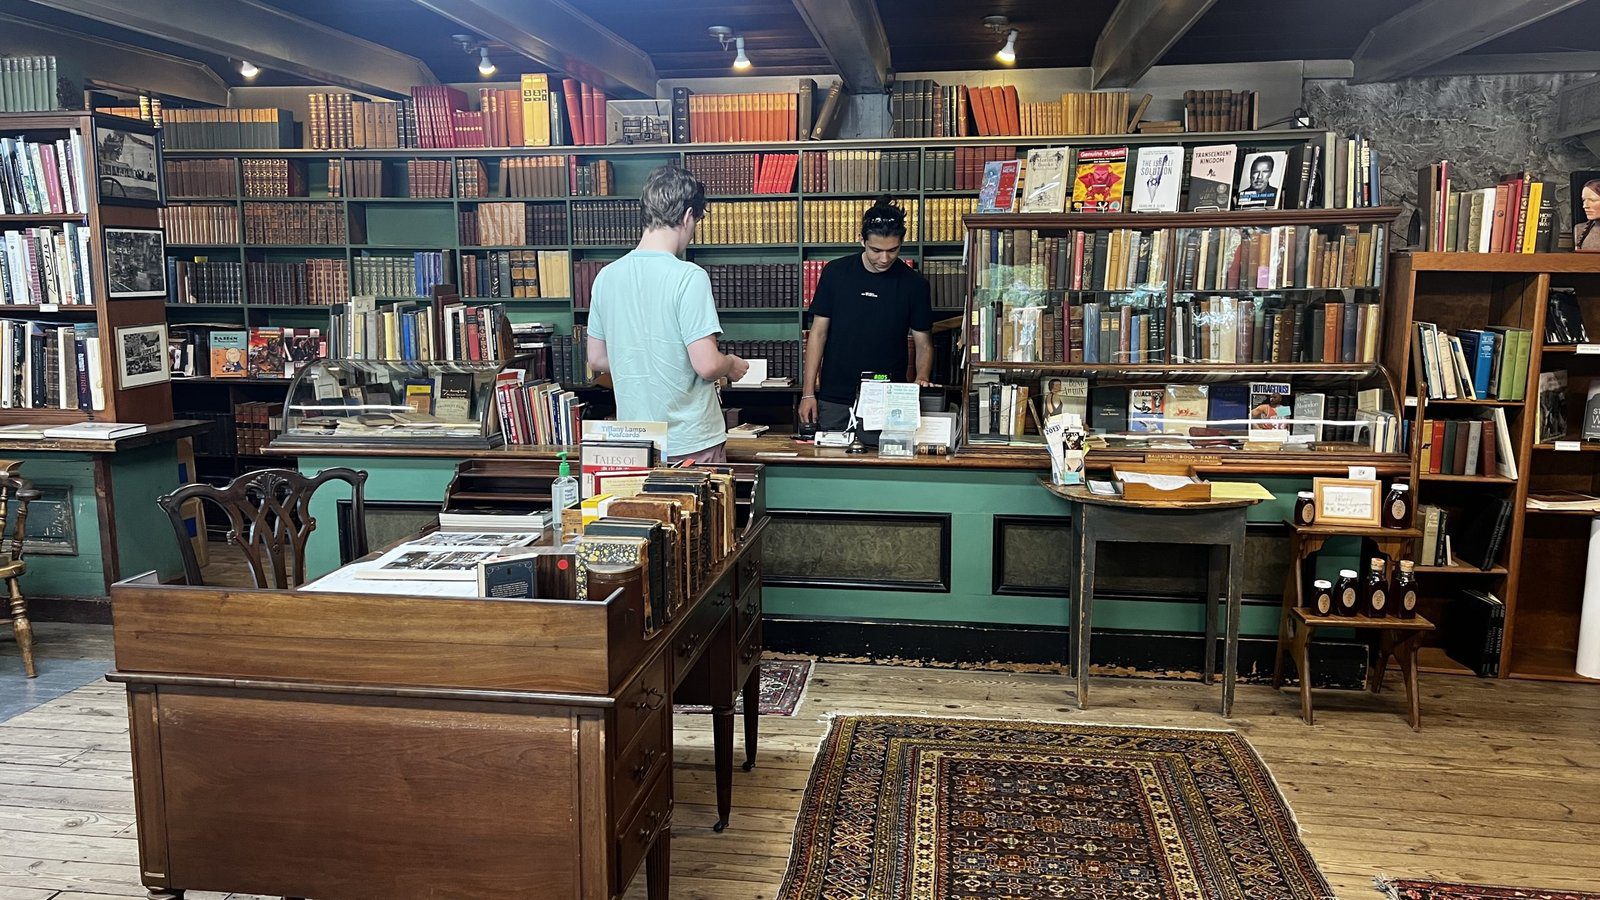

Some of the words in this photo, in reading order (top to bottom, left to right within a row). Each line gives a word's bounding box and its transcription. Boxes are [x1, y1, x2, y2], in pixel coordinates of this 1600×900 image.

[1080, 150, 1103, 158] Genuine
[1103, 148, 1126, 157] Origami
[1195, 150, 1232, 158] TRANSCENDENT
[1153, 159, 1174, 167] ISRELI
[1140, 167, 1173, 176] SOLUTON
[601, 425, 624, 433] Tiffany
[592, 454, 621, 465] TALES
[623, 456, 636, 465] OF
